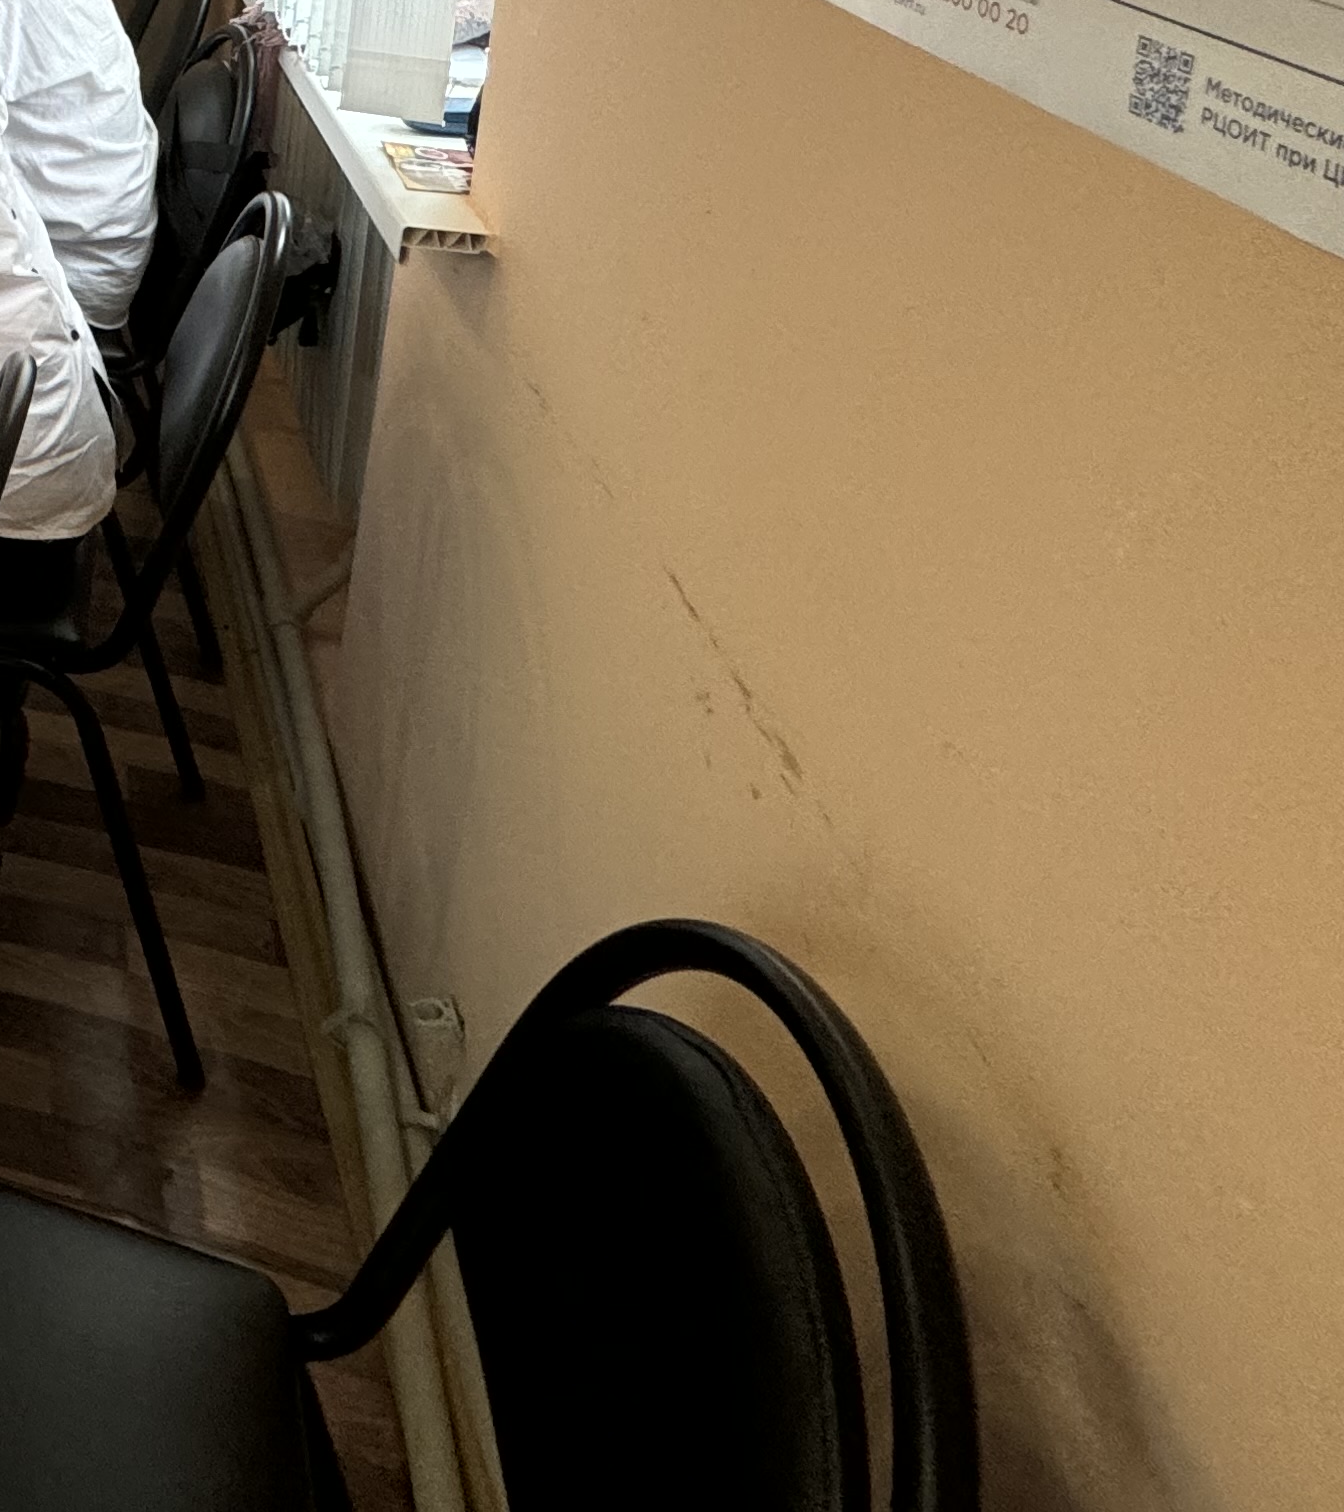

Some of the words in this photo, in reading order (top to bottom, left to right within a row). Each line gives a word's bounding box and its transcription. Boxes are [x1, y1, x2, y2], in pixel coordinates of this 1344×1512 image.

[1006, 9, 1030, 35] 20
[1200, 107, 1271, 152] РЦОИТ
[1275, 143, 1316, 176] при
[1322, 162, 1344, 189] Ц
